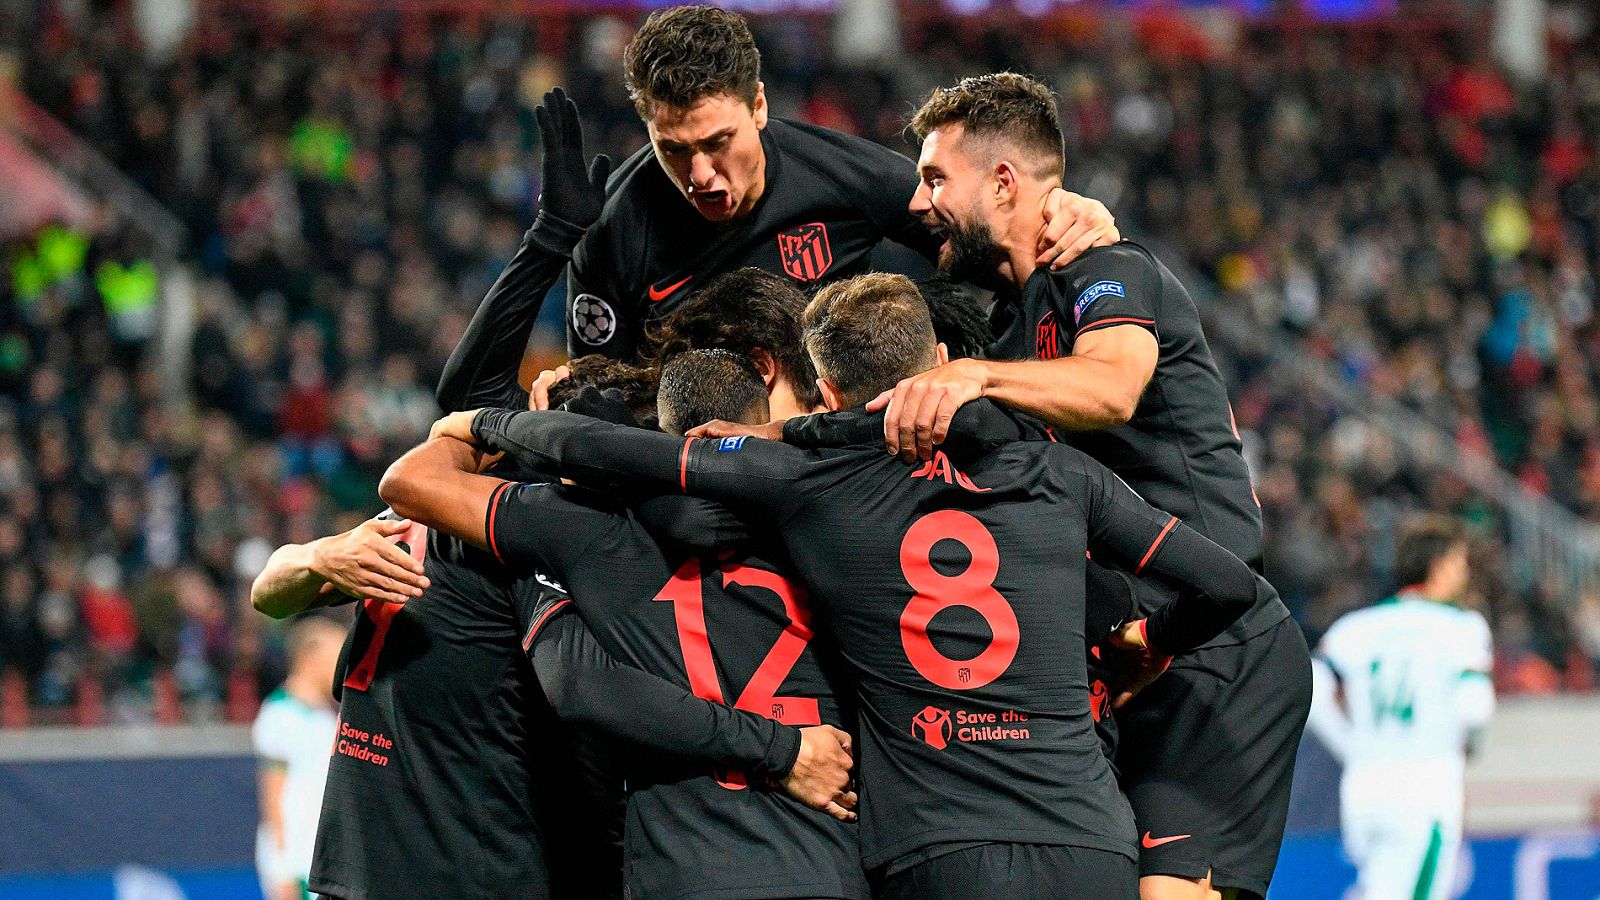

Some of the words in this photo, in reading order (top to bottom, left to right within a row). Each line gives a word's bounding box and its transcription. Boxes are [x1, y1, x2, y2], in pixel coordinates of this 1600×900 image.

[1079, 284, 1123, 309] RESPECT
[899, 509, 1020, 690] 8
[651, 555, 822, 726] 12
[956, 710, 997, 725] Save
[1001, 709, 1029, 722] the
[340, 722, 370, 743] Save
[372, 733, 393, 750] the
[957, 726, 1030, 742] Children
[338, 739, 389, 767] Children
